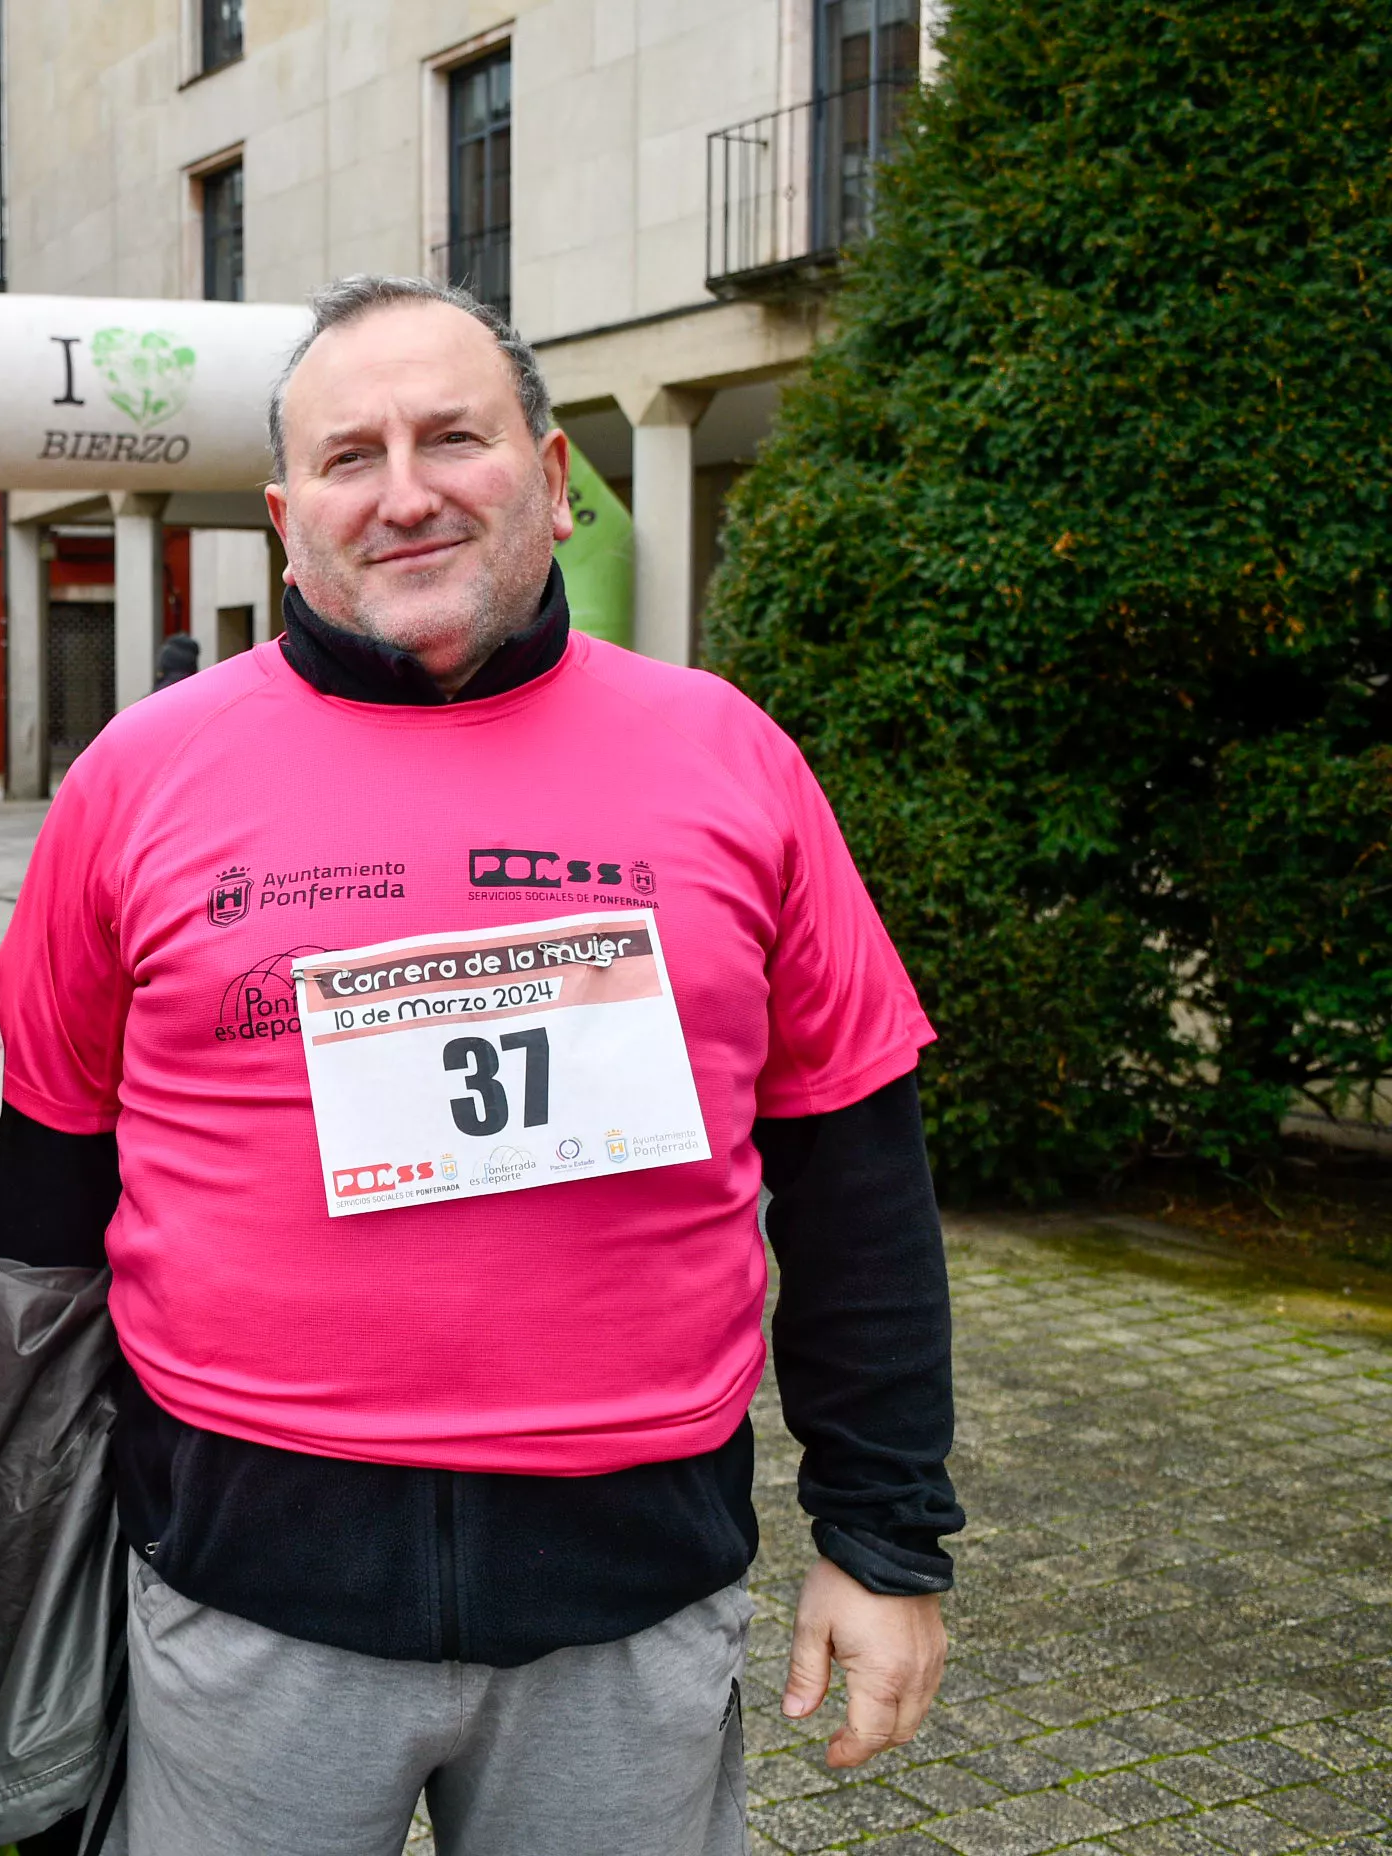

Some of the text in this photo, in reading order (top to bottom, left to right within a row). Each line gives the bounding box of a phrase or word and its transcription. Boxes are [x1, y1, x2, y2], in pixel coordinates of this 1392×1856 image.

[50, 336, 85, 406] I
[37, 430, 191, 465] BIERZO
[262, 862, 406, 888] Ayuntamiento
[259, 880, 406, 909] Ponferrada
[468, 891, 660, 909] SERVICIOS SOCIALES DE PONFERRADA
[332, 936, 632, 995] Carrera de la mujer
[334, 980, 553, 1030] 10 de Marzo 2024
[239, 1017, 301, 1041] depo
[442, 1027, 550, 1137] 37
[632, 1129, 697, 1145] Ayuntamiento
[633, 1139, 699, 1158] Ponferrada
[483, 1160, 537, 1177] Ponferrada
[574, 1158, 595, 1168] Estado
[469, 1172, 522, 1186] es deporte
[336, 1183, 460, 1208] SERVICIOS SOCIALES DE PONFERRADA
